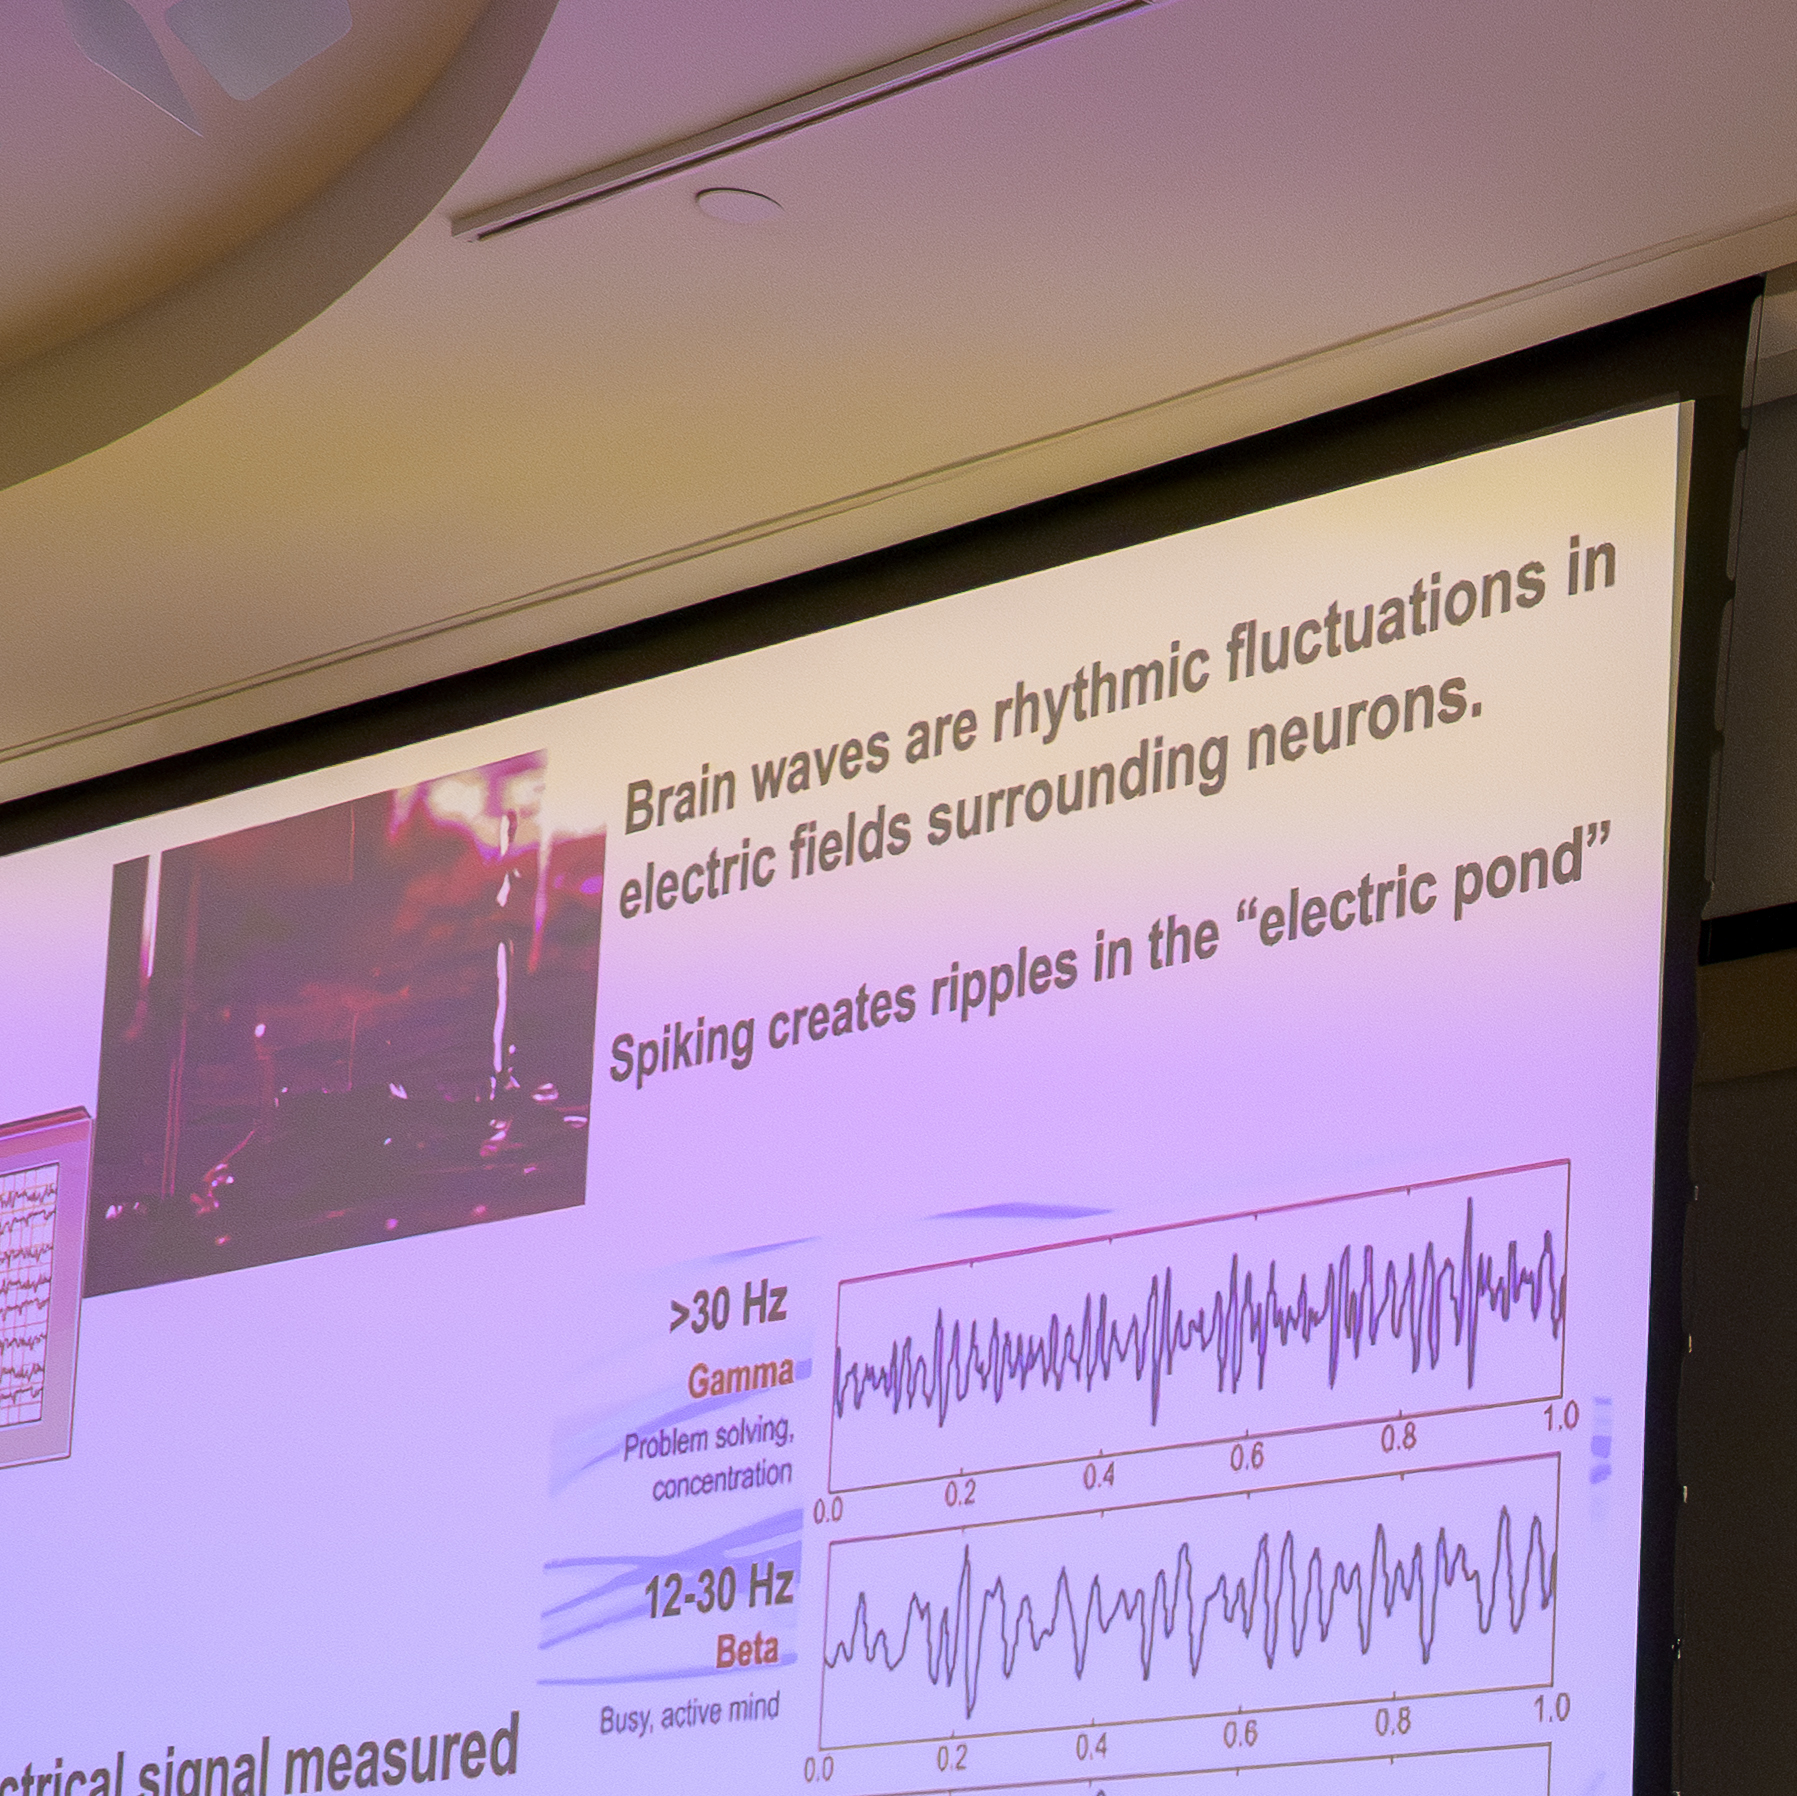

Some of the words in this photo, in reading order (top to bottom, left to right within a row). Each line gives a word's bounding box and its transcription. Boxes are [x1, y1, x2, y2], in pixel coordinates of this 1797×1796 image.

[625, 762, 737, 836] Brain
[752, 730, 891, 802] waves
[904, 712, 979, 760] are
[993, 642, 1211, 745] rhythmic
[1227, 557, 1547, 682] fluctuations
[1566, 536, 1617, 596] in
[617, 841, 777, 919] electric
[790, 802, 912, 880] fields
[927, 735, 1230, 850] surrounding
[1246, 675, 1484, 772] neurons.
[609, 1014, 756, 1090] Spiking
[768, 977, 918, 1051] creates
[930, 946, 1079, 1021] ripples
[1095, 929, 1133, 980] in
[1148, 914, 1220, 970] the
[1234, 864, 1438, 948] “electric
[1452, 819, 1613, 921] pond”
[669, 1289, 731, 1337] >30
[743, 1276, 788, 1325] Hz
[686, 1358, 795, 1399] Gamma
[623, 1427, 708, 1463] Problem
[715, 1415, 795, 1455] solving,
[812, 1495, 845, 1524] 0.0
[945, 1479, 977, 1508] 0.2
[1082, 1460, 1117, 1491] 0.4
[1230, 1442, 1265, 1472] 0.6
[1381, 1420, 1418, 1451] 0.8
[1543, 1402, 1580, 1432] 1.0
[651, 1460, 793, 1502] concentration
[644, 1572, 735, 1619] 12-30
[747, 1561, 795, 1606] Hz
[716, 1632, 780, 1668] Beta
[600, 1705, 653, 1738] Busy,
[661, 1698, 721, 1729] active
[728, 1691, 781, 1722] mind
[803, 1756, 835, 1784] 0.0
[937, 1743, 967, 1771] 0.2
[1075, 1732, 1109, 1761] 0.4
[1222, 1719, 1259, 1749] 0.6
[1375, 1707, 1413, 1738] 0.8
[1533, 1693, 1572, 1723] 1.0
[285, 1710, 520, 1795] measured
